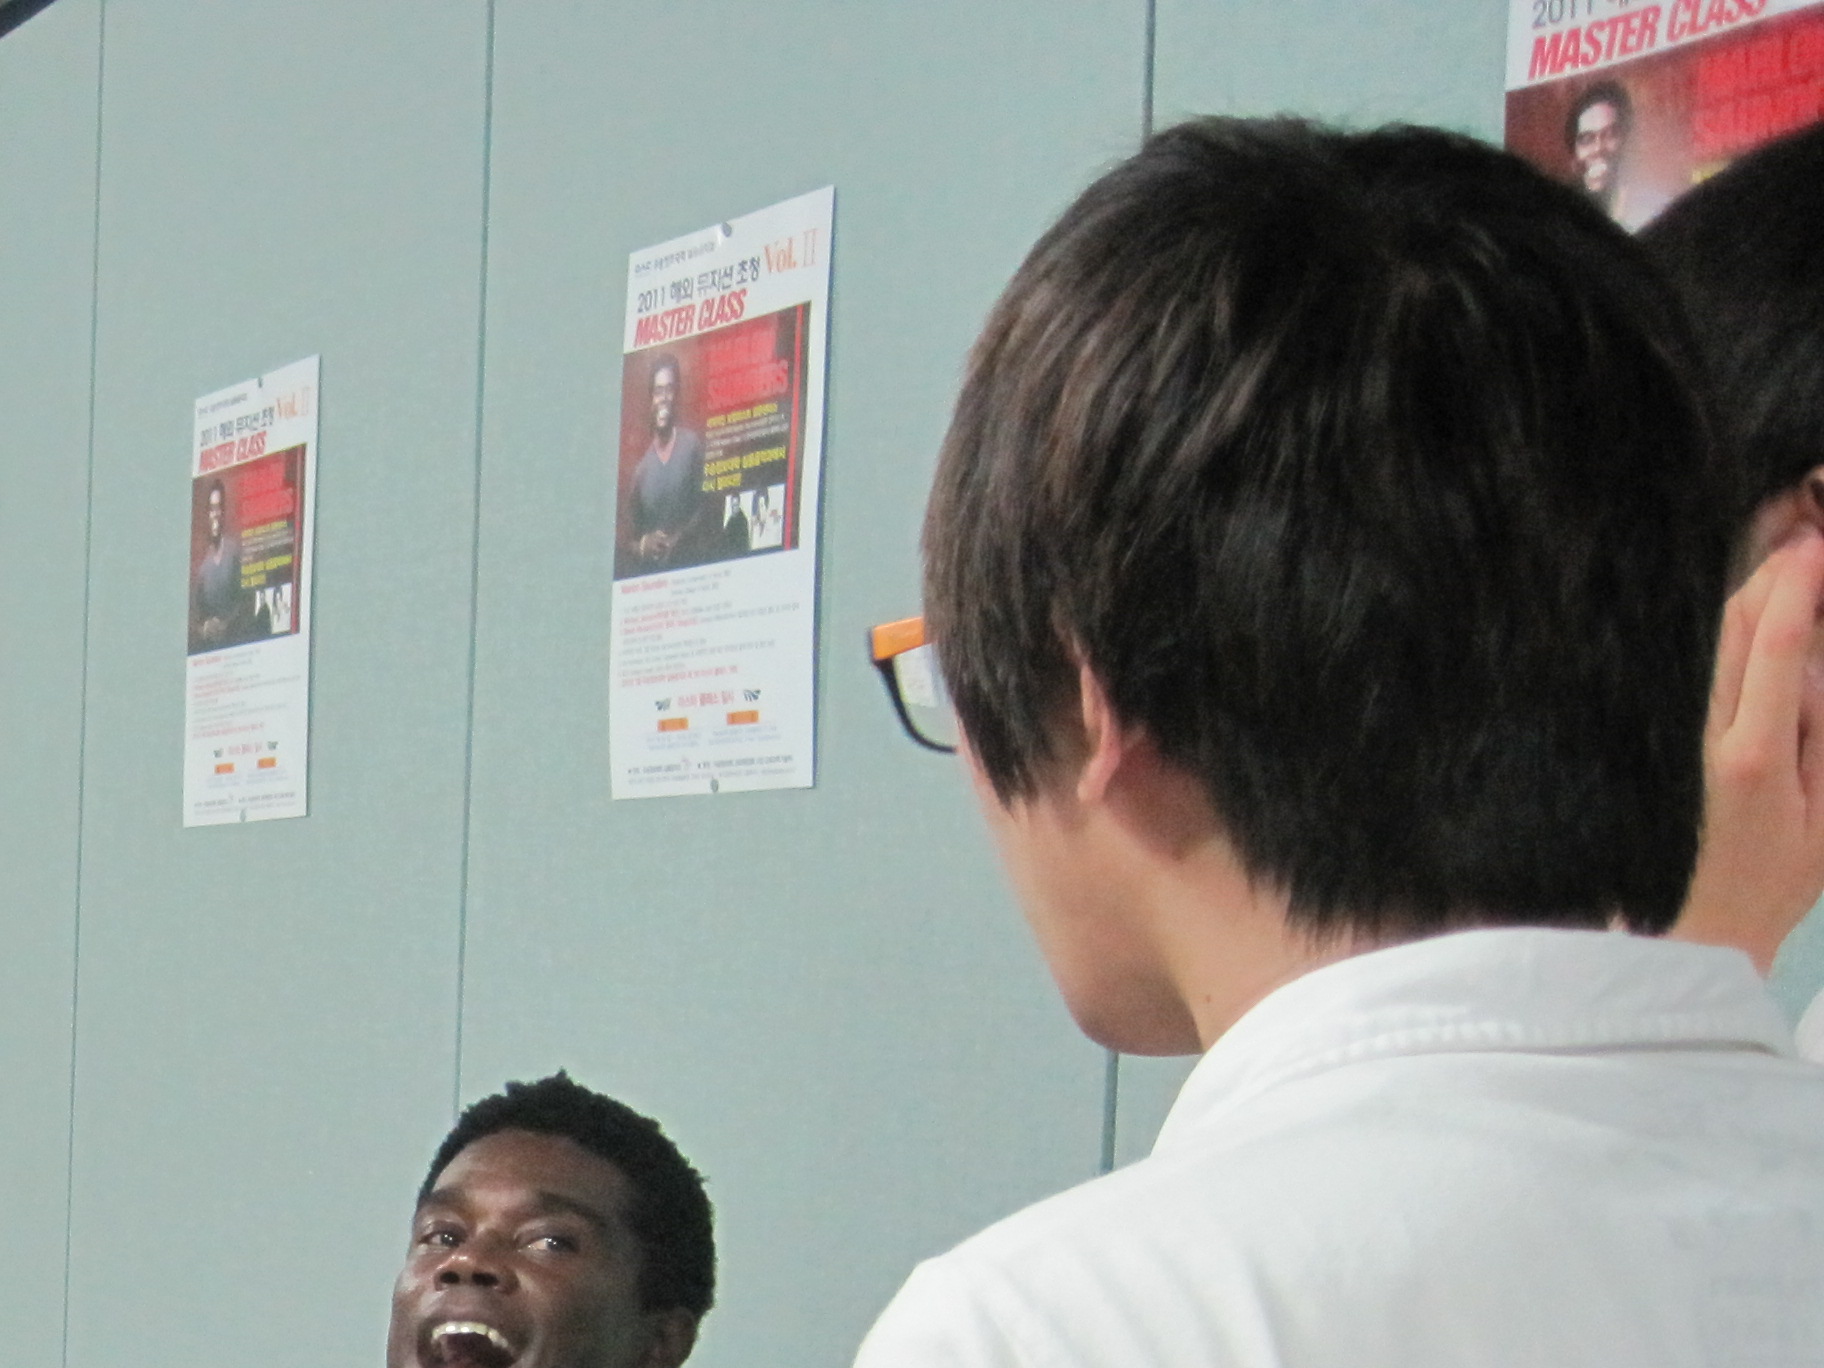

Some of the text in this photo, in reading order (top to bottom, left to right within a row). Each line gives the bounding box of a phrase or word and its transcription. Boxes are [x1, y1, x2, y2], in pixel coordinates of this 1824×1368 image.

[1528, 5, 1662, 80] MASTER
[637, 286, 665, 314] 2011
[670, 277, 694, 303] 해외
[697, 265, 734, 297] 뮤지션
[736, 256, 760, 284] 초청
[634, 288, 748, 348] MASTER CLASS
